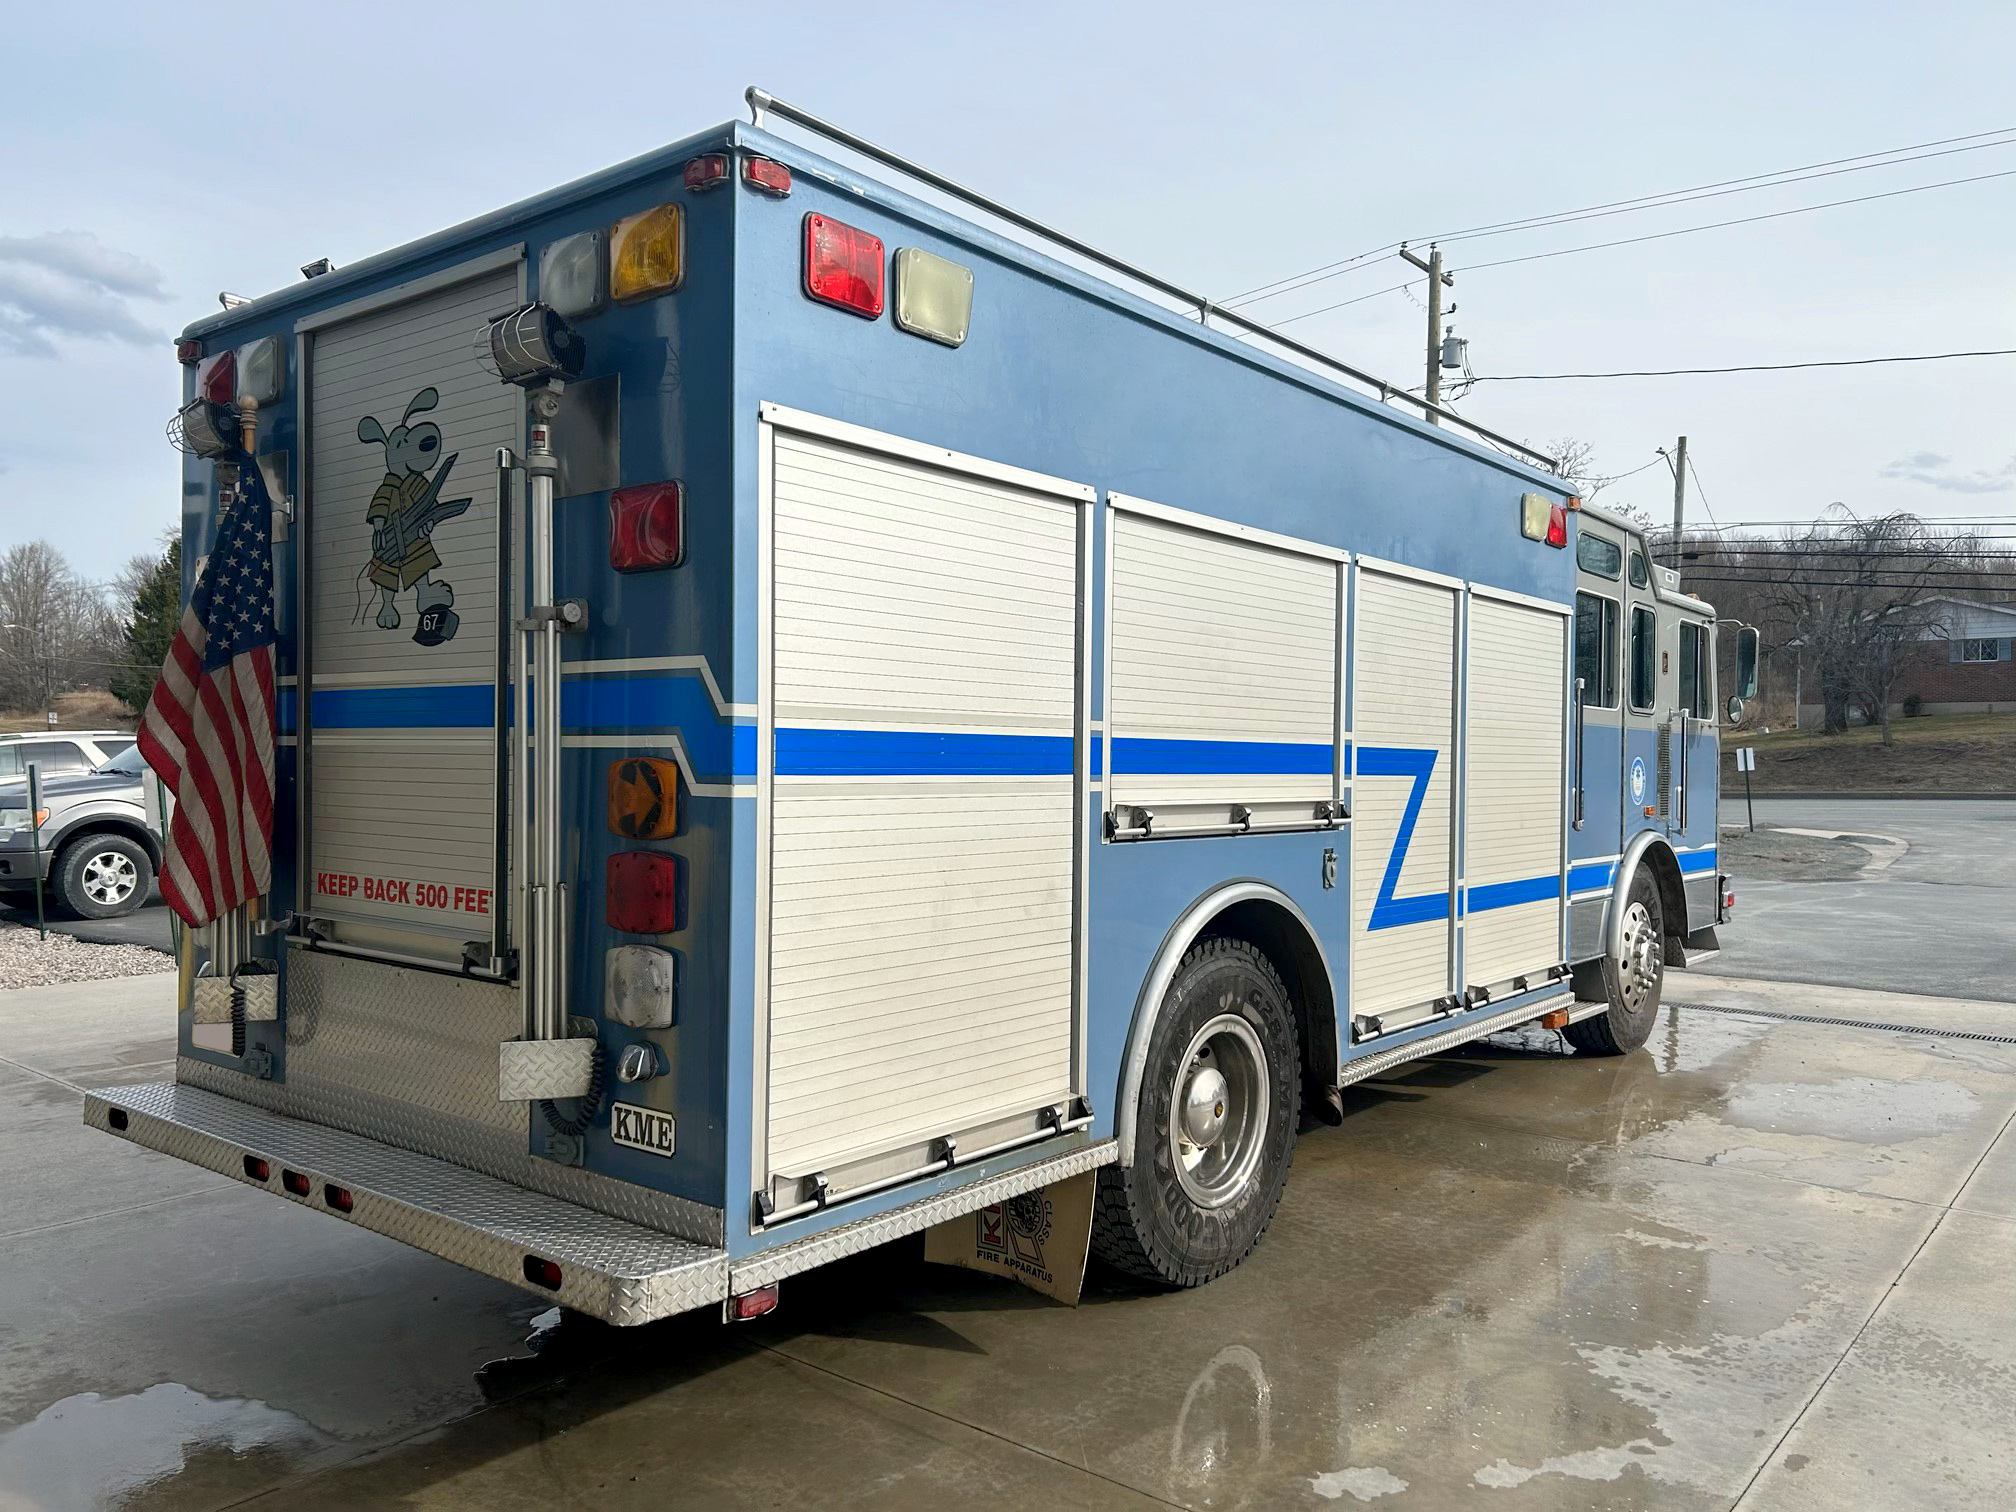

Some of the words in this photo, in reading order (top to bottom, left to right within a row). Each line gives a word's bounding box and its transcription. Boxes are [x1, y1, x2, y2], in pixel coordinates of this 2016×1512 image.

[423, 613, 439, 631] 67
[317, 872, 359, 897] KEEP
[363, 877, 411, 904] BACK
[415, 883, 448, 909] 500
[453, 886, 493, 914] FEE
[613, 1105, 672, 1153] KME
[1037, 1200, 1053, 1246] CLASS
[976, 1249, 1000, 1264] FIRE
[1003, 1256, 1053, 1284] APPARATUS
